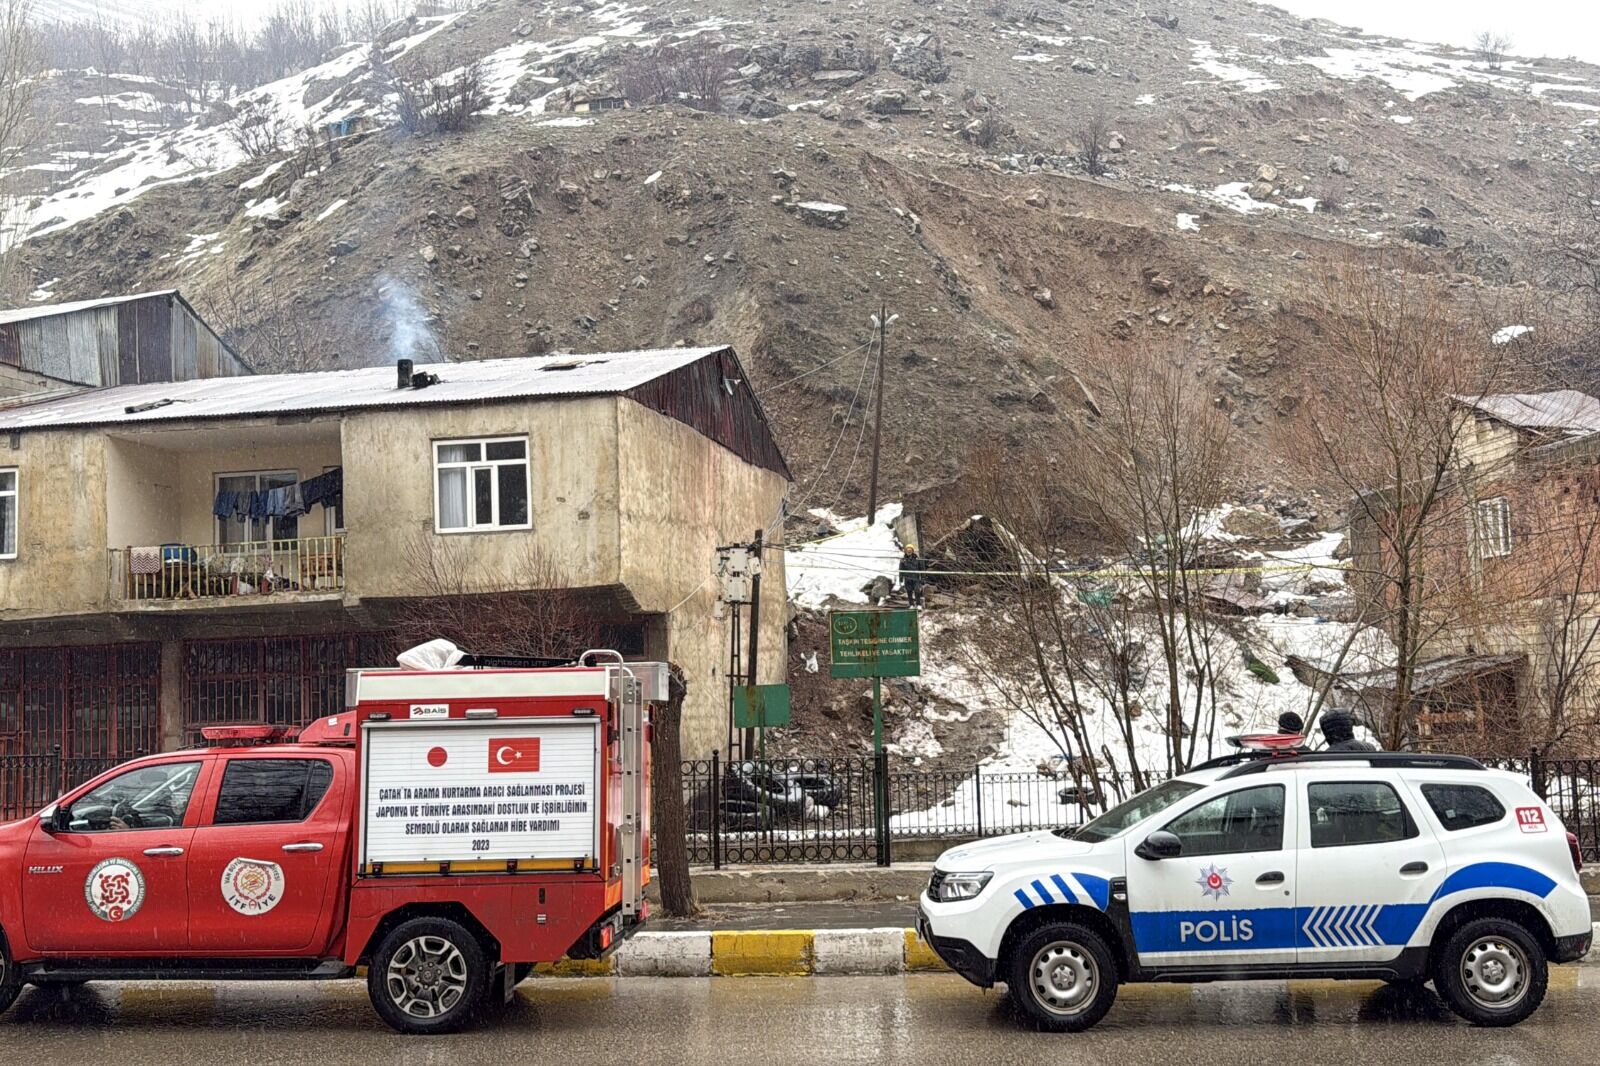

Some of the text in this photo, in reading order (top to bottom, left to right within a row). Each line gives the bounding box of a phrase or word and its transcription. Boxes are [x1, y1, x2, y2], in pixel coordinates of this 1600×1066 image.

[414, 787, 440, 799] ARAMA
[442, 786, 481, 799] KURTARMA
[483, 786, 505, 798] ARACI
[506, 783, 553, 797] SAĞLANMASI
[376, 806, 408, 818] JAPONYA
[410, 805, 419, 817] VE
[421, 802, 450, 817] TÜRKİYE
[452, 802, 495, 816] ARASINDAKİ
[497, 803, 529, 815] DOSTLUK
[531, 802, 540, 814] VE
[1519, 809, 1541, 823] 112
[405, 818, 560, 835] SEMBOLÜ OLARAK SAĞLANAN HİBE YARDIMI
[471, 839, 490, 851] 2023
[28, 865, 65, 875] HILUX
[1180, 914, 1254, 943] POLİS
